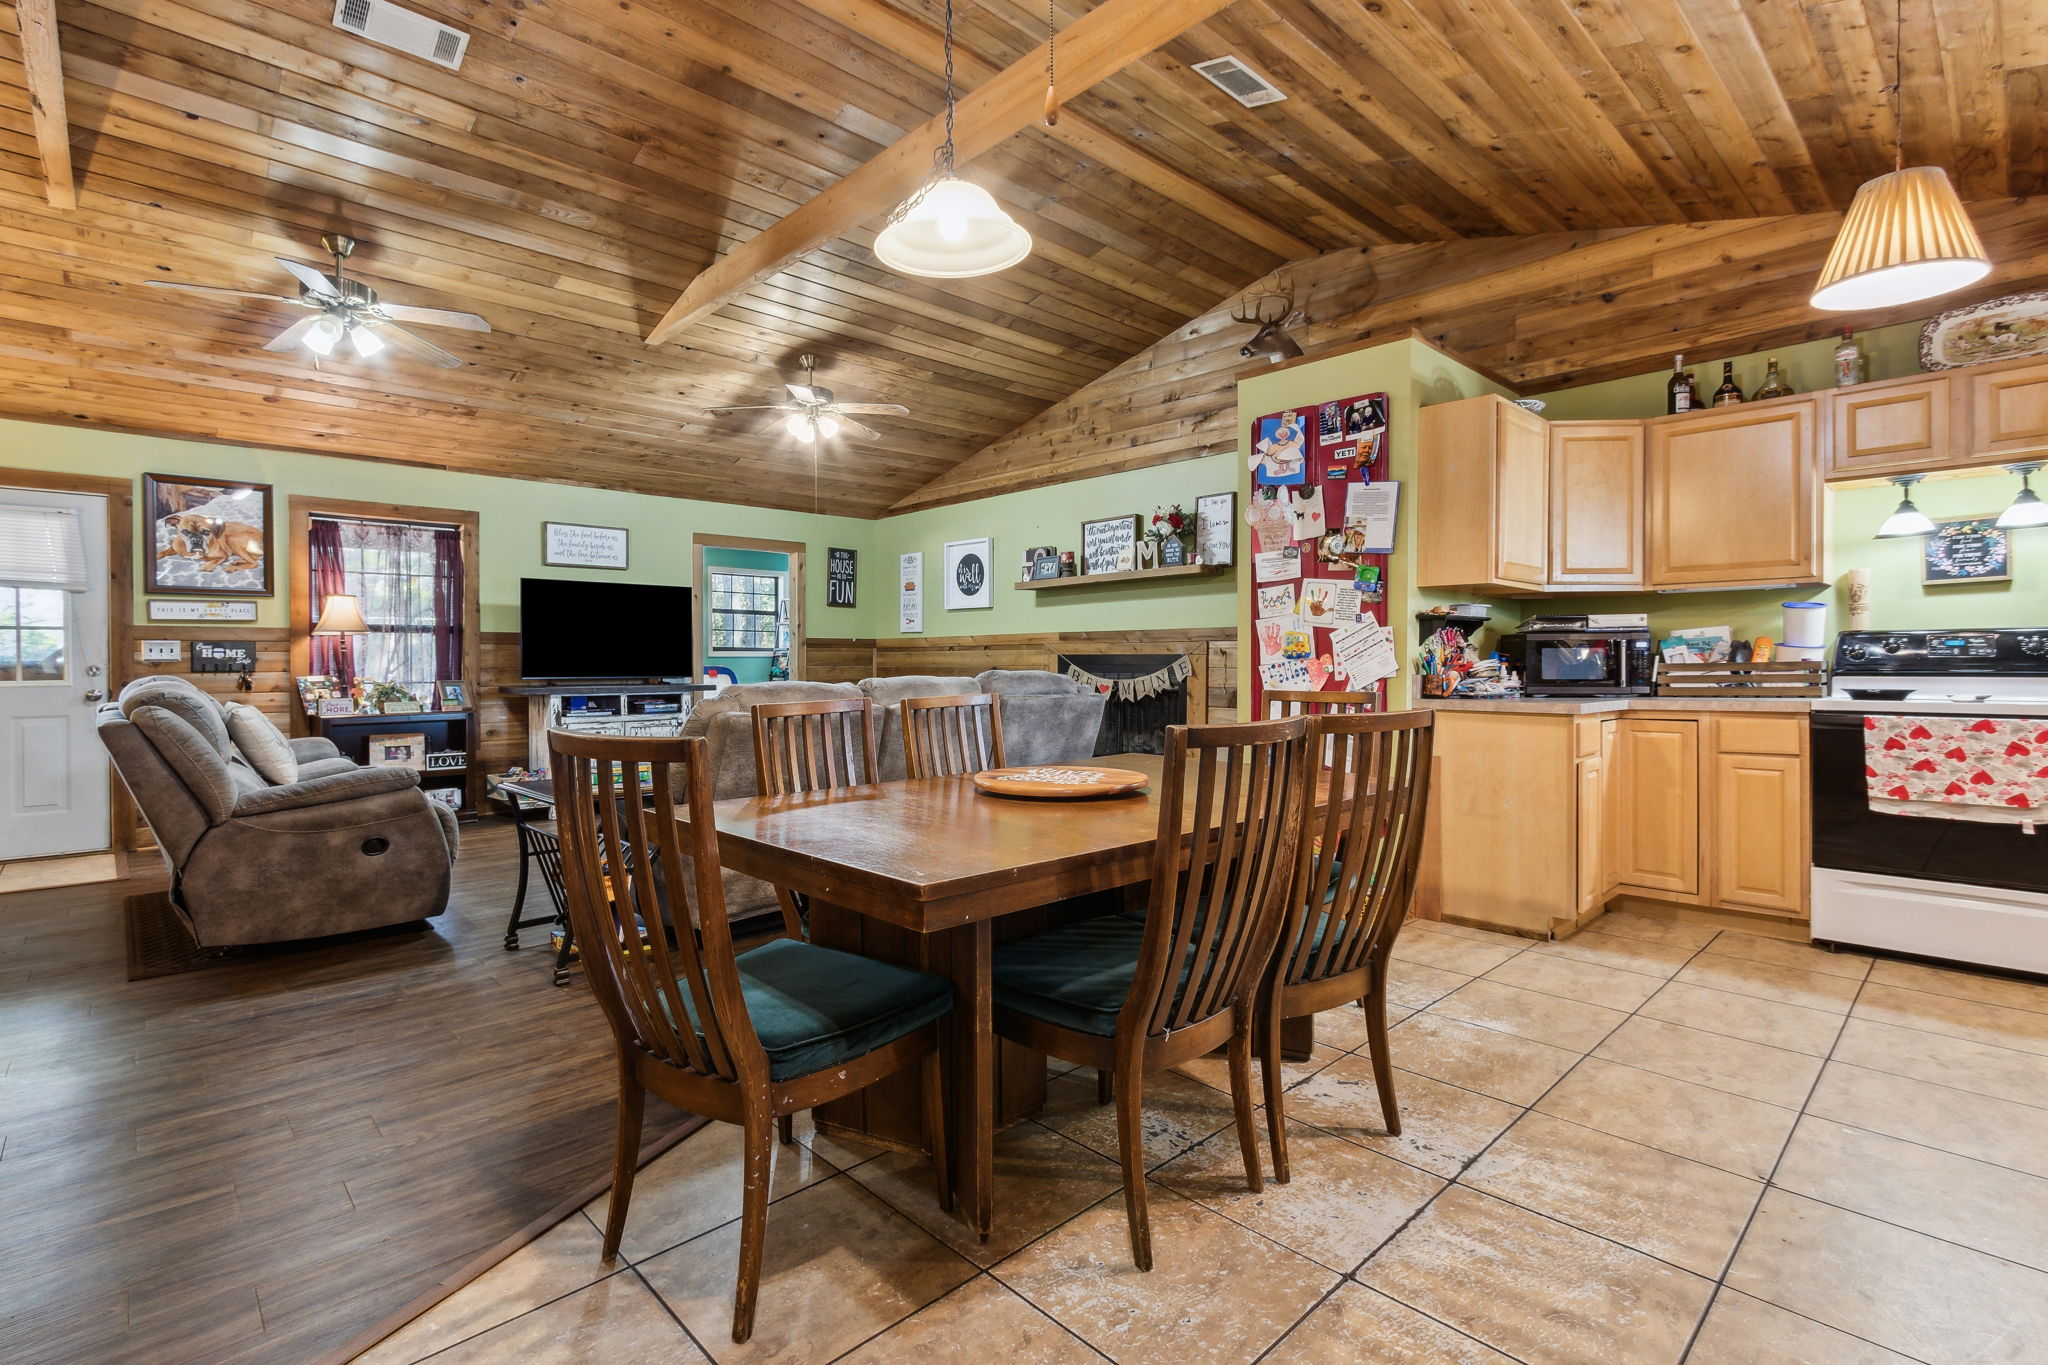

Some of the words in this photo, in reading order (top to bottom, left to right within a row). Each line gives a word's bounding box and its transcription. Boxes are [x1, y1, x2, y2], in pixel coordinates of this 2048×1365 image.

[1336, 449, 1355, 457] YETI
[554, 528, 568, 537] Bless
[580, 530, 592, 539] food
[593, 532, 610, 540] before
[568, 541, 589, 550] family
[1137, 541, 1159, 570] M
[830, 559, 853, 574] HOUSE
[960, 563, 980, 584] well
[829, 580, 854, 604] FUN
[195, 642, 213, 651] Come
[1121, 661, 1190, 696] MINE
[430, 755, 467, 768] LOVE
